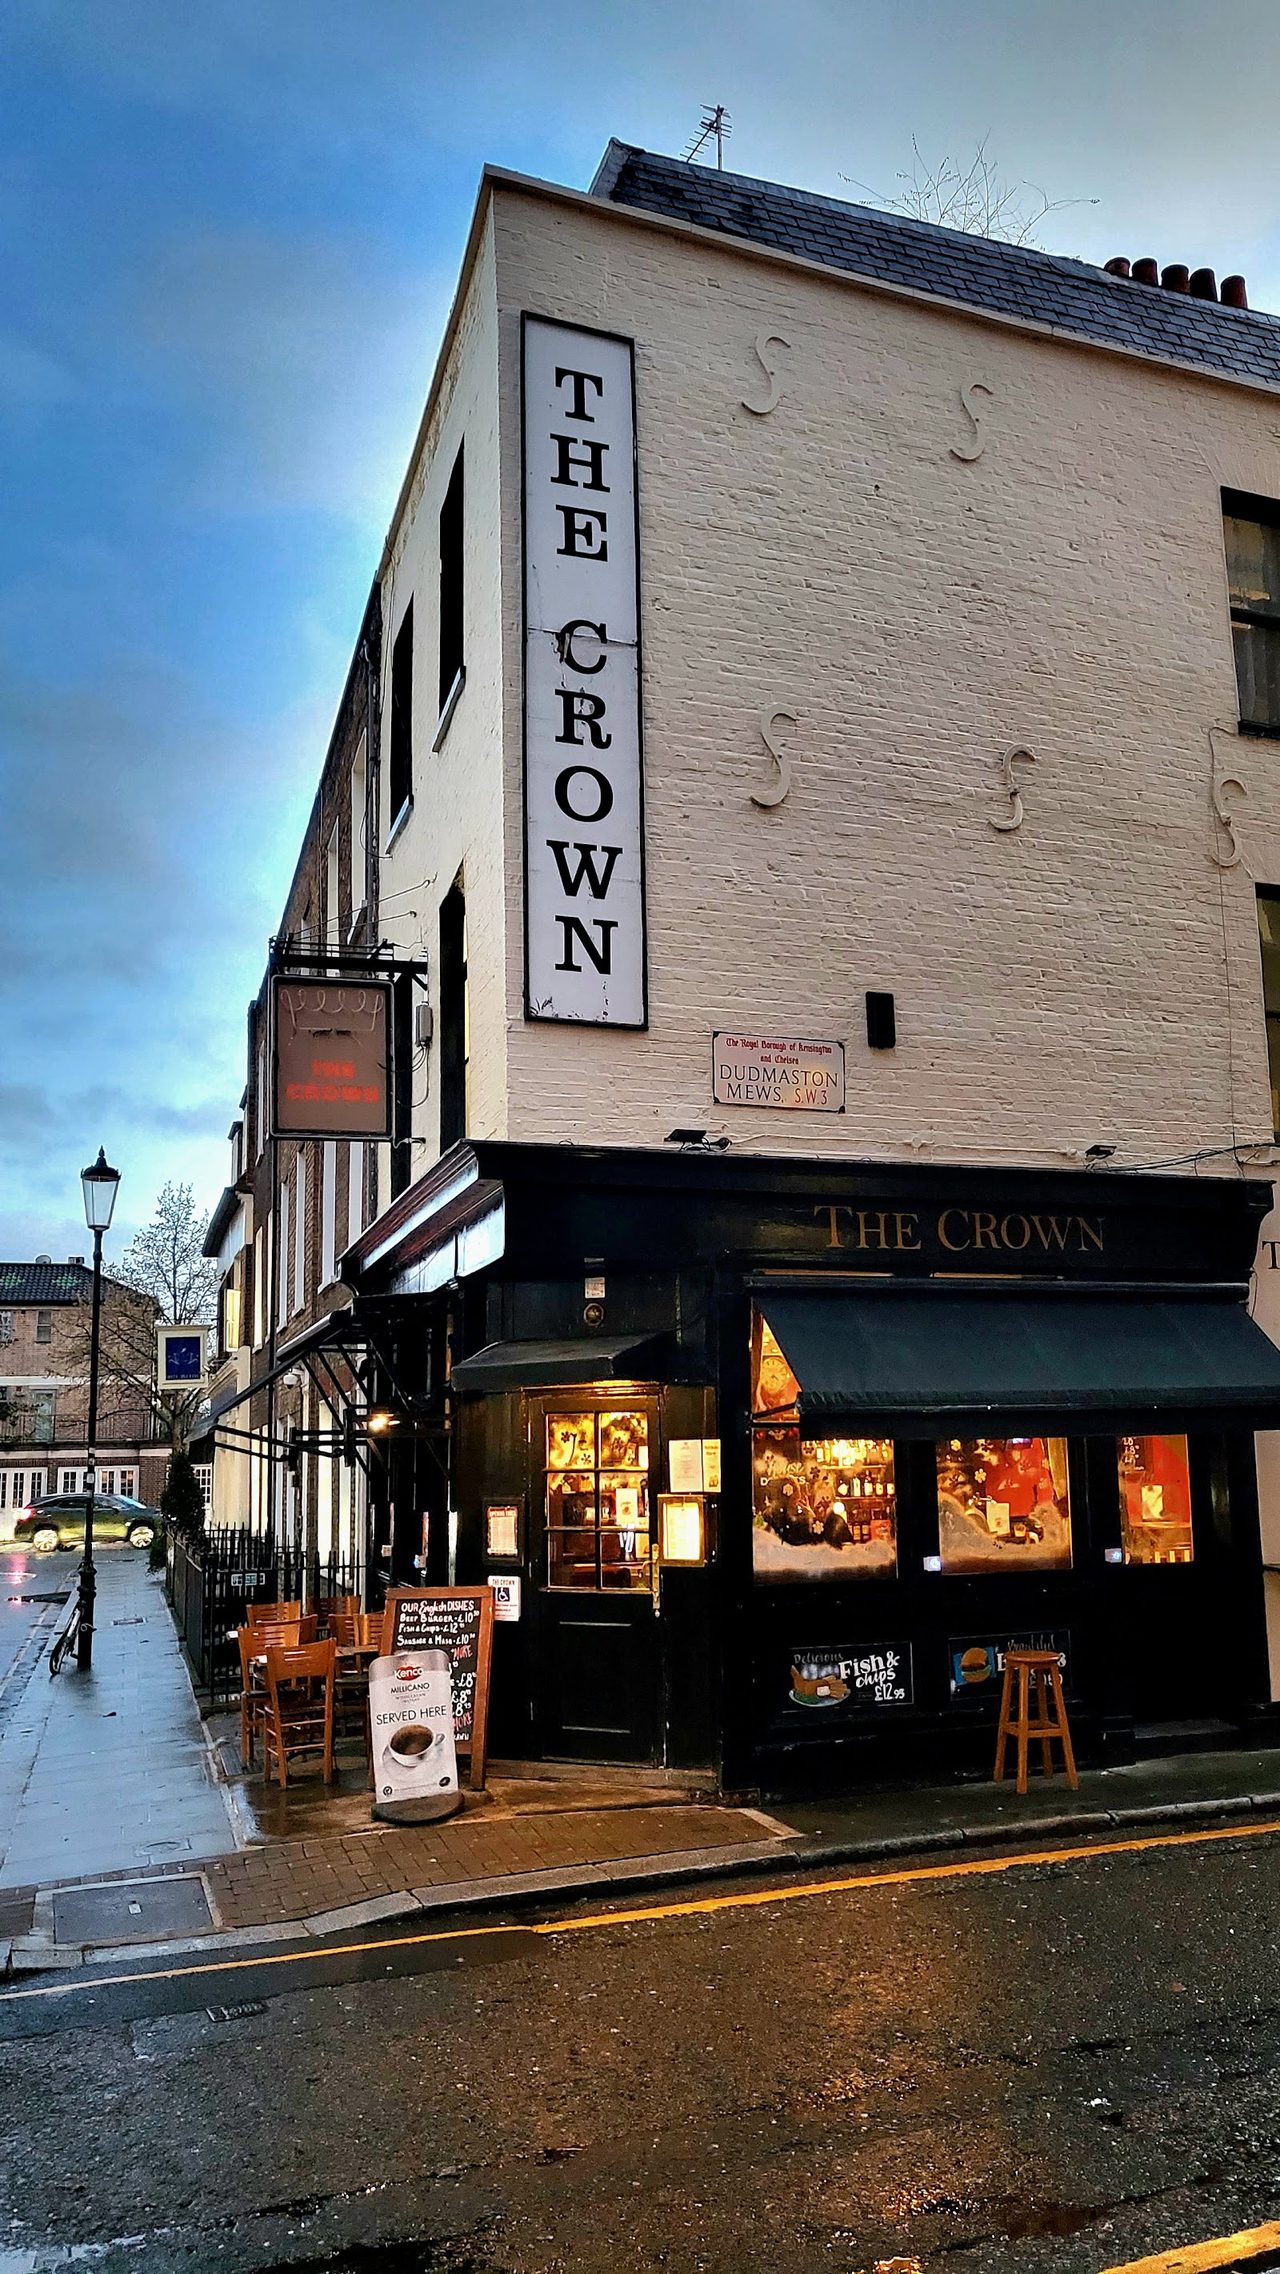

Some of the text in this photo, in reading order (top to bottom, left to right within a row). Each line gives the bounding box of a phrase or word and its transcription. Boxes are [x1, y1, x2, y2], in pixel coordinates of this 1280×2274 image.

[546, 366, 624, 976] THE CROWN
[725, 1037, 832, 1055] The Royal Borough of Kensington
[760, 1054, 799, 1064] and Chelsea
[720, 1064, 838, 1087] DUDMASTON
[814, 1204, 1104, 1252] THE CROWN
[401, 1600, 474, 1616] OUR English DISHES
[394, 1667, 424, 1678] Kenco
[390, 1682, 430, 1694] MILLICANO
[376, 1709, 417, 1725] SERVED
[420, 1705, 447, 1719] HERE
